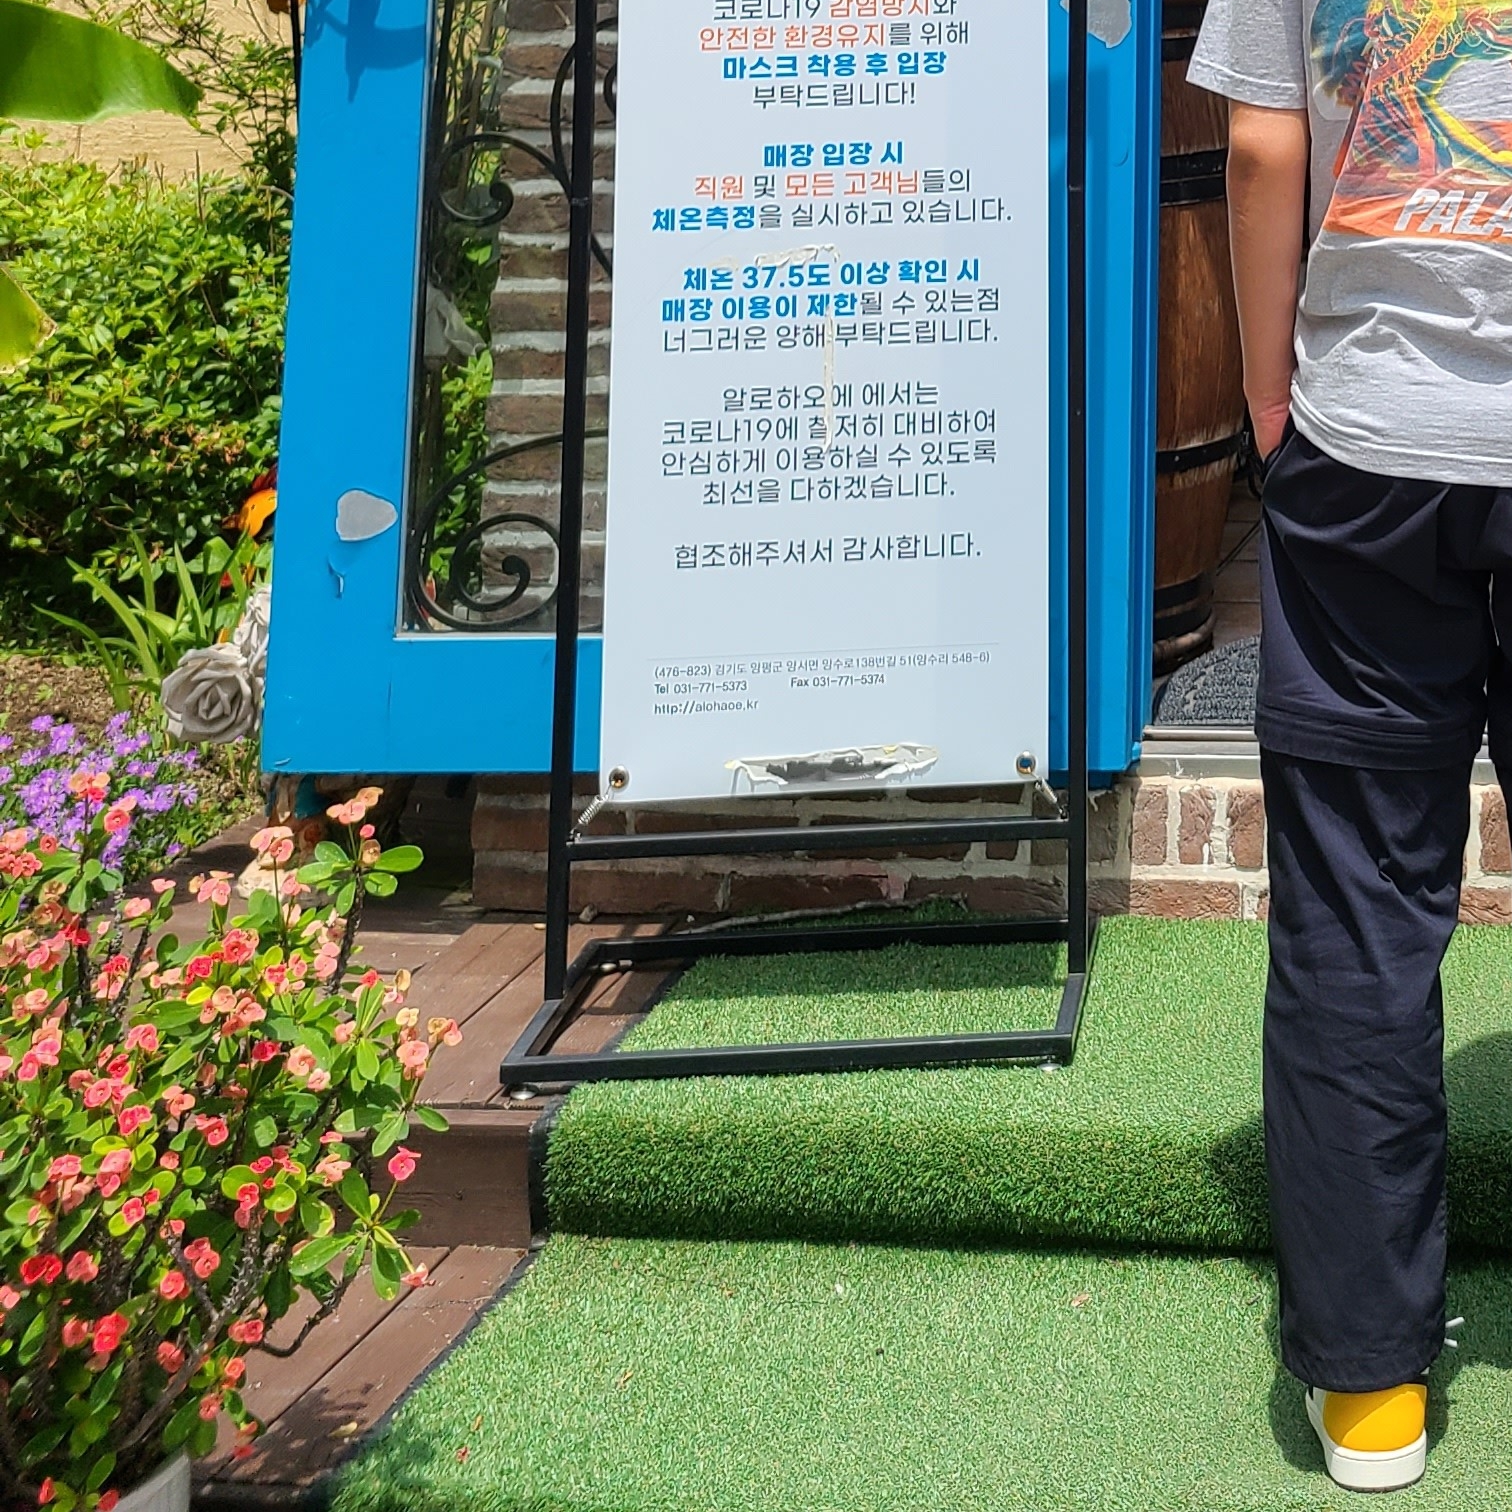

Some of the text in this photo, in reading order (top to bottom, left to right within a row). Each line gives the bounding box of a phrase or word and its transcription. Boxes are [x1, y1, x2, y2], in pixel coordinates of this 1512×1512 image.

[700, 20, 970, 51] 안전한 환경유지를 위해
[723, 50, 947, 80] 마스크 착용 후 입장
[752, 81, 917, 110] 부탁드립니다!
[763, 141, 904, 169] 매장 입장 시
[694, 168, 971, 200] 직원 및 모든 고객님들의
[652, 197, 1012, 231] 체온측정을 실시하고 있습니다.
[683, 258, 980, 291] 체온 37.5도 이상 확인 시
[662, 287, 1000, 322] 매장 이용이 제한될 수 있는점
[663, 318, 999, 354] 너그러운 양해 부탁드립니다.
[723, 380, 939, 413] 알로하오에 에서는
[662, 417, 799, 447] 코로나19에
[894, 408, 997, 436] 대비하여
[662, 438, 998, 478] 안심하게 이용하실 수 있도록
[703, 472, 956, 506] 최선을 다하겠습니다.
[675, 532, 982, 571] 협조해주셔서 감사합니다.
[654, 673, 886, 695] Tel 031-771-5373 Fax 031-771-5374
